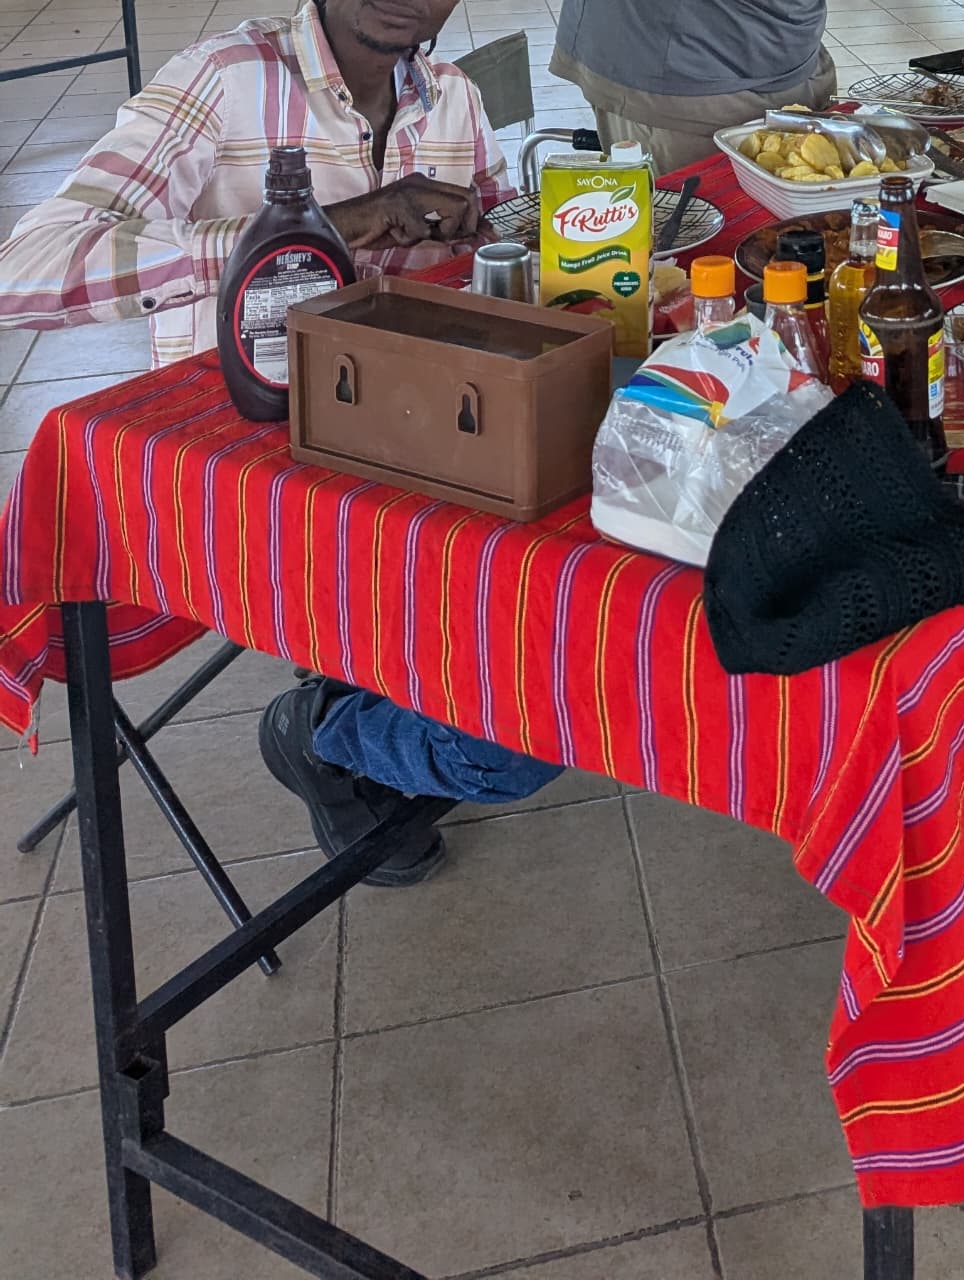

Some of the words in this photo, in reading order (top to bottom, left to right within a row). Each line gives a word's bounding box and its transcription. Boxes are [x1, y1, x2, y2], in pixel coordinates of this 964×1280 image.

[576, 175, 618, 189] SAYONA
[276, 252, 312, 265] HERSHEY'S
[560, 260, 581, 269] Mango
[581, 256, 596, 267] Fruit
[596, 251, 610, 262] Juice
[611, 249, 628, 257] Drink
[861, 360, 879, 377] ARO
